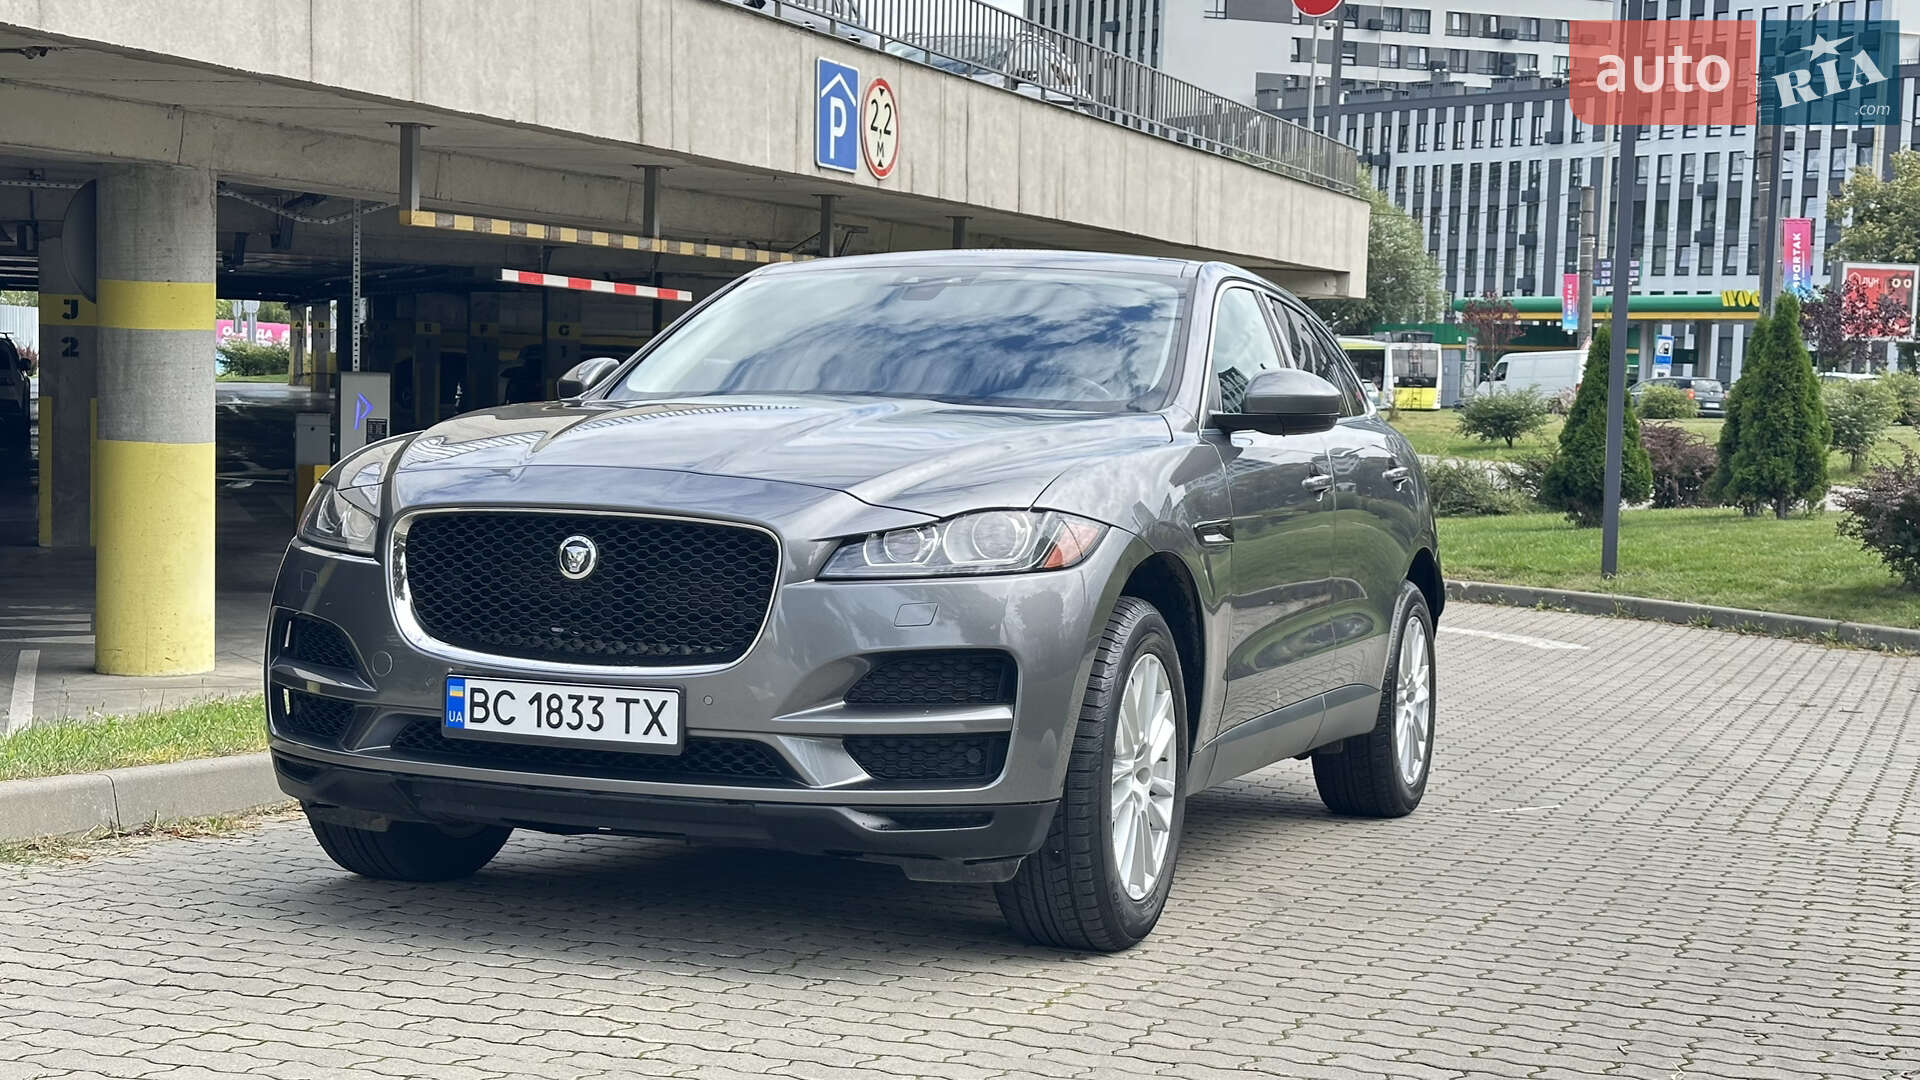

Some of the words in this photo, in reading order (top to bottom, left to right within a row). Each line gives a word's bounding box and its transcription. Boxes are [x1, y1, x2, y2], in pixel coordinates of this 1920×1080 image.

[829, 96, 847, 160] P
[870, 98, 892, 139] 2,2
[62, 299, 79, 320] J
[62, 336, 79, 357] 2
[449, 710, 463, 723] UA
[469, 687, 516, 726] BC
[528, 691, 605, 732] 1833
[615, 696, 668, 737] TX
